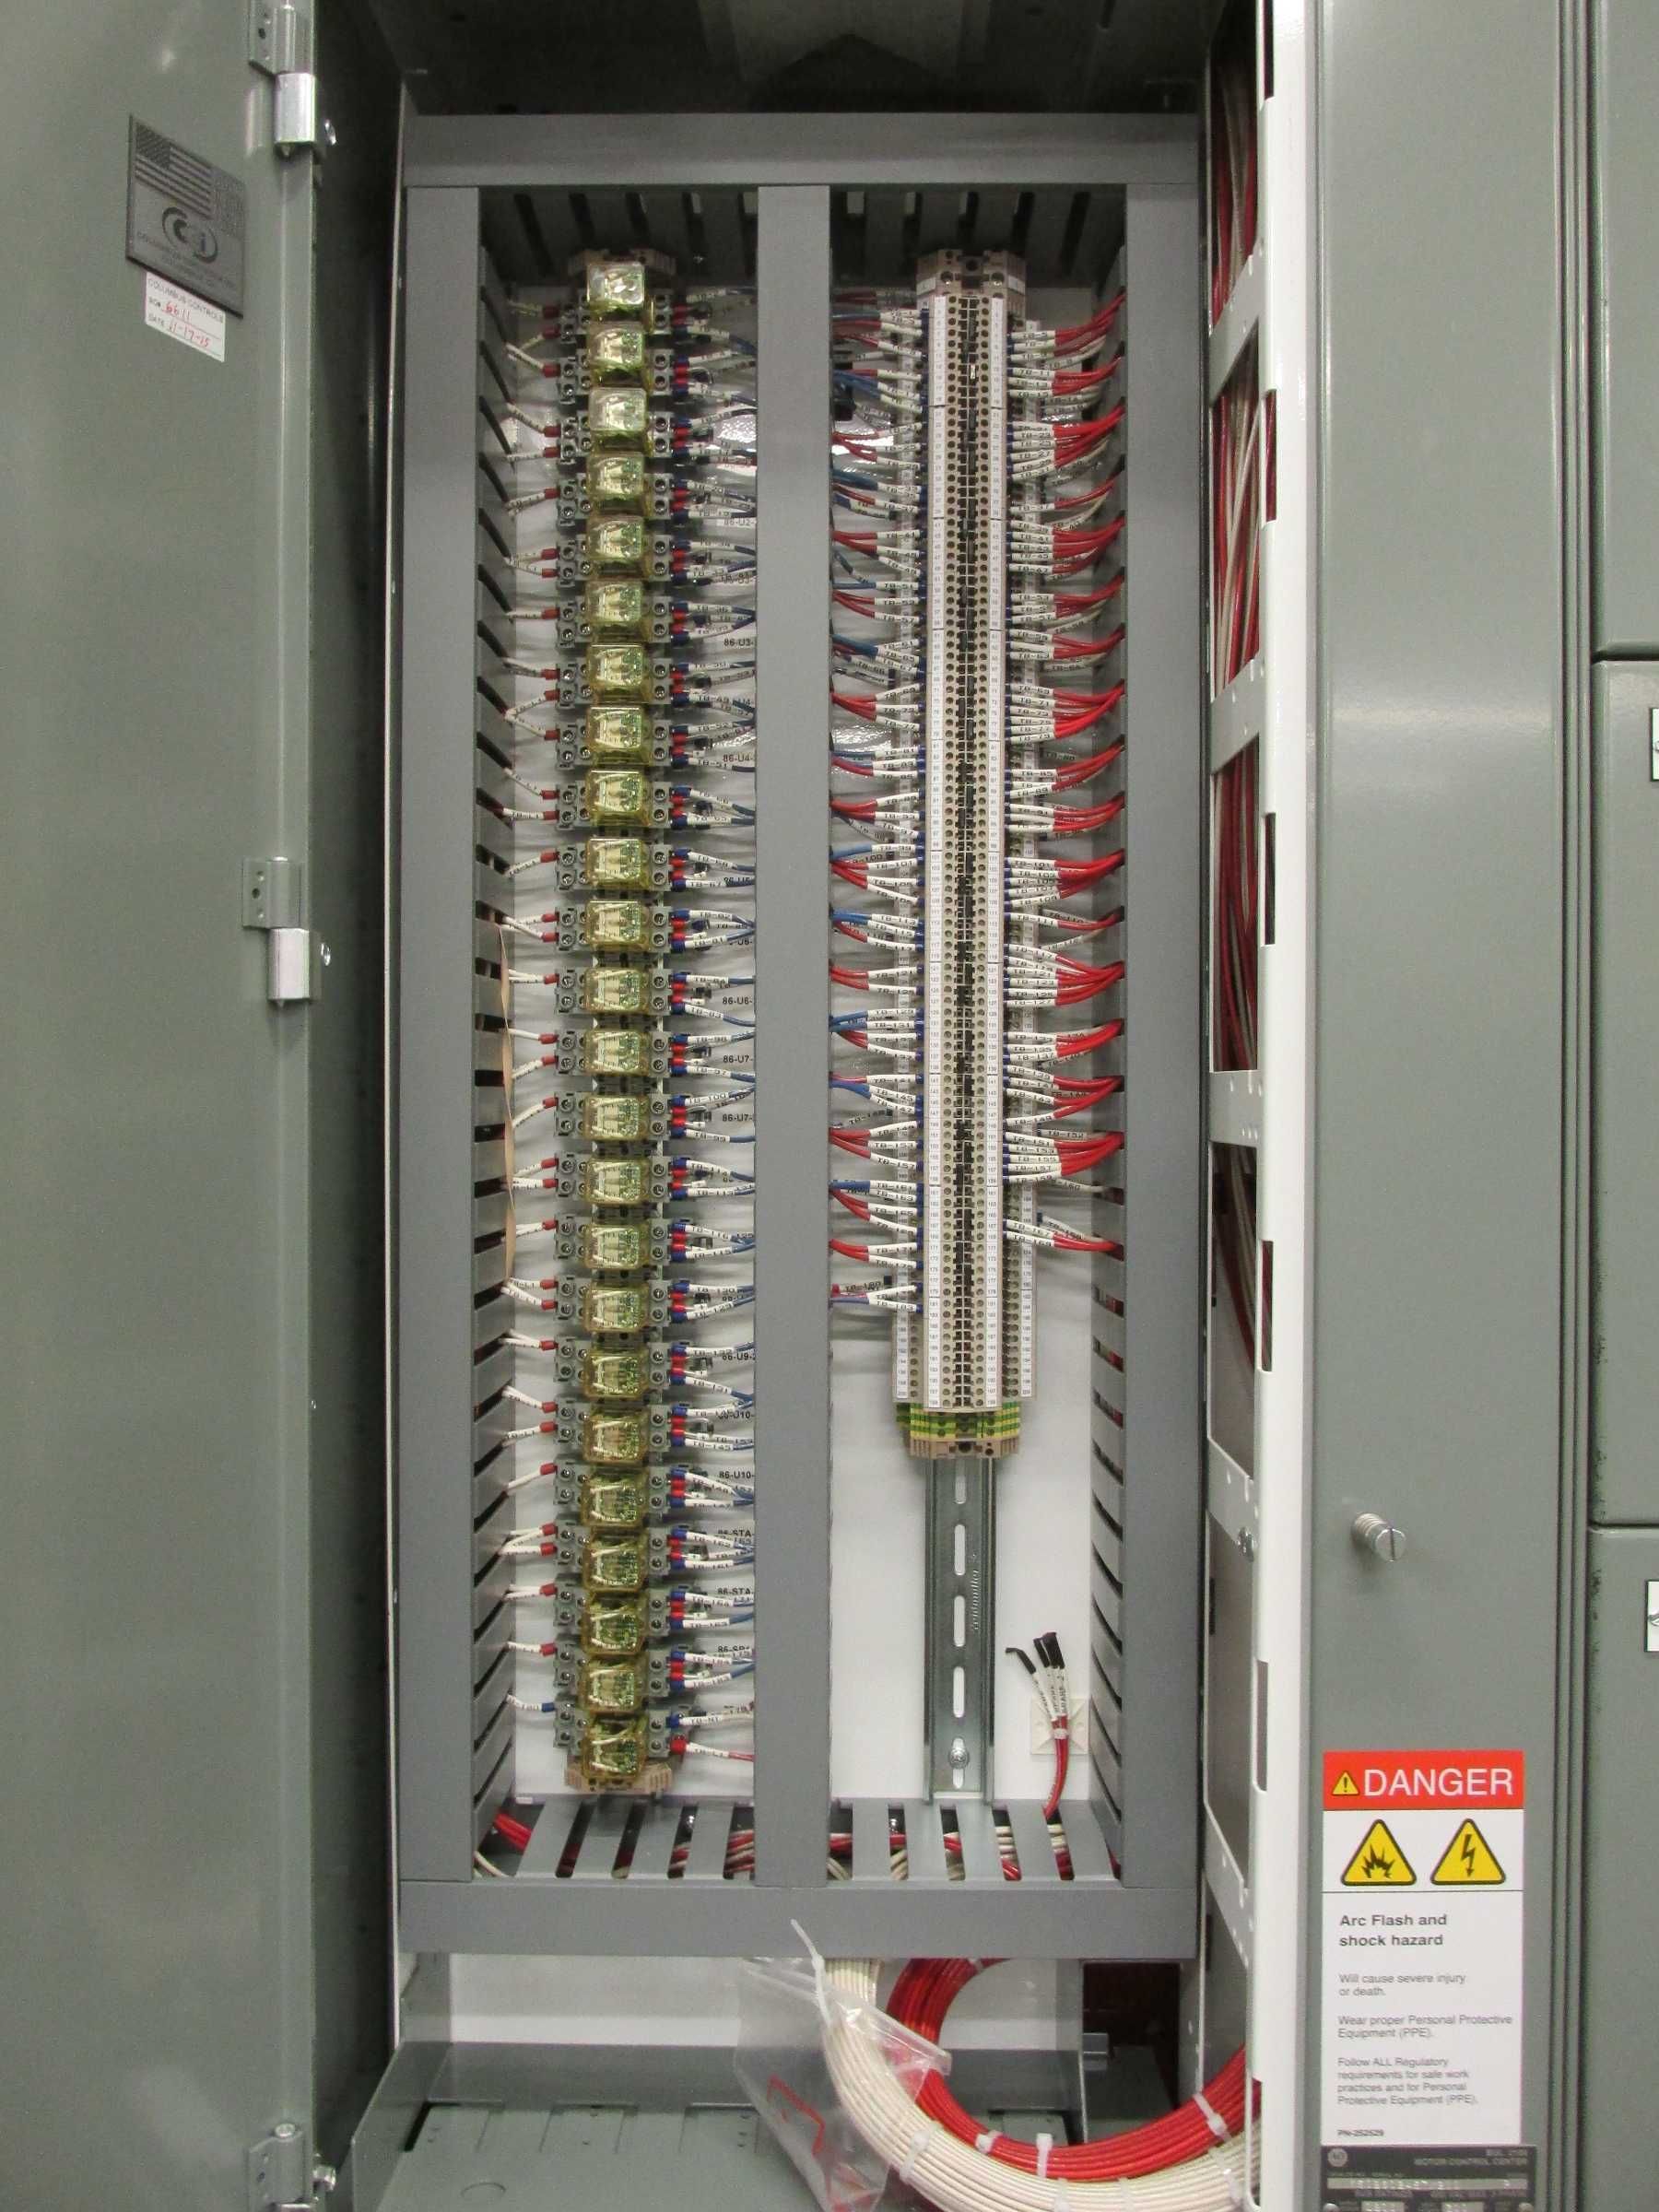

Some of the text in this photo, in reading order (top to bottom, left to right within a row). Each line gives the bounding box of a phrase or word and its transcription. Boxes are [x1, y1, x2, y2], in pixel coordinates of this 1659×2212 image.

[1020, 697, 1050, 707] TB-71
[1363, 1768, 1514, 1797] DANGER
[1339, 1913, 1447, 1926] Arc Flash and
[1339, 1935, 1443, 1947] shock hazard
[1338, 1973, 1359, 1983] Will
[1361, 1975, 1394, 1983] cause
[1437, 1973, 1466, 1985] injury
[1338, 1986, 1386, 1996] or death.
[1338, 2015, 1512, 2028] Wear proper Personal Protective
[1338, 2028, 1433, 2040] Equipment (PPE).
[1337, 2057, 1449, 2068] Follow ALL Regulatory
[1337, 2070, 1469, 2081] requirements for safe work
[1337, 2082, 1466, 2094] practices and for Personal
[1337, 2094, 1478, 2106] Protective Equipment (PPE).
